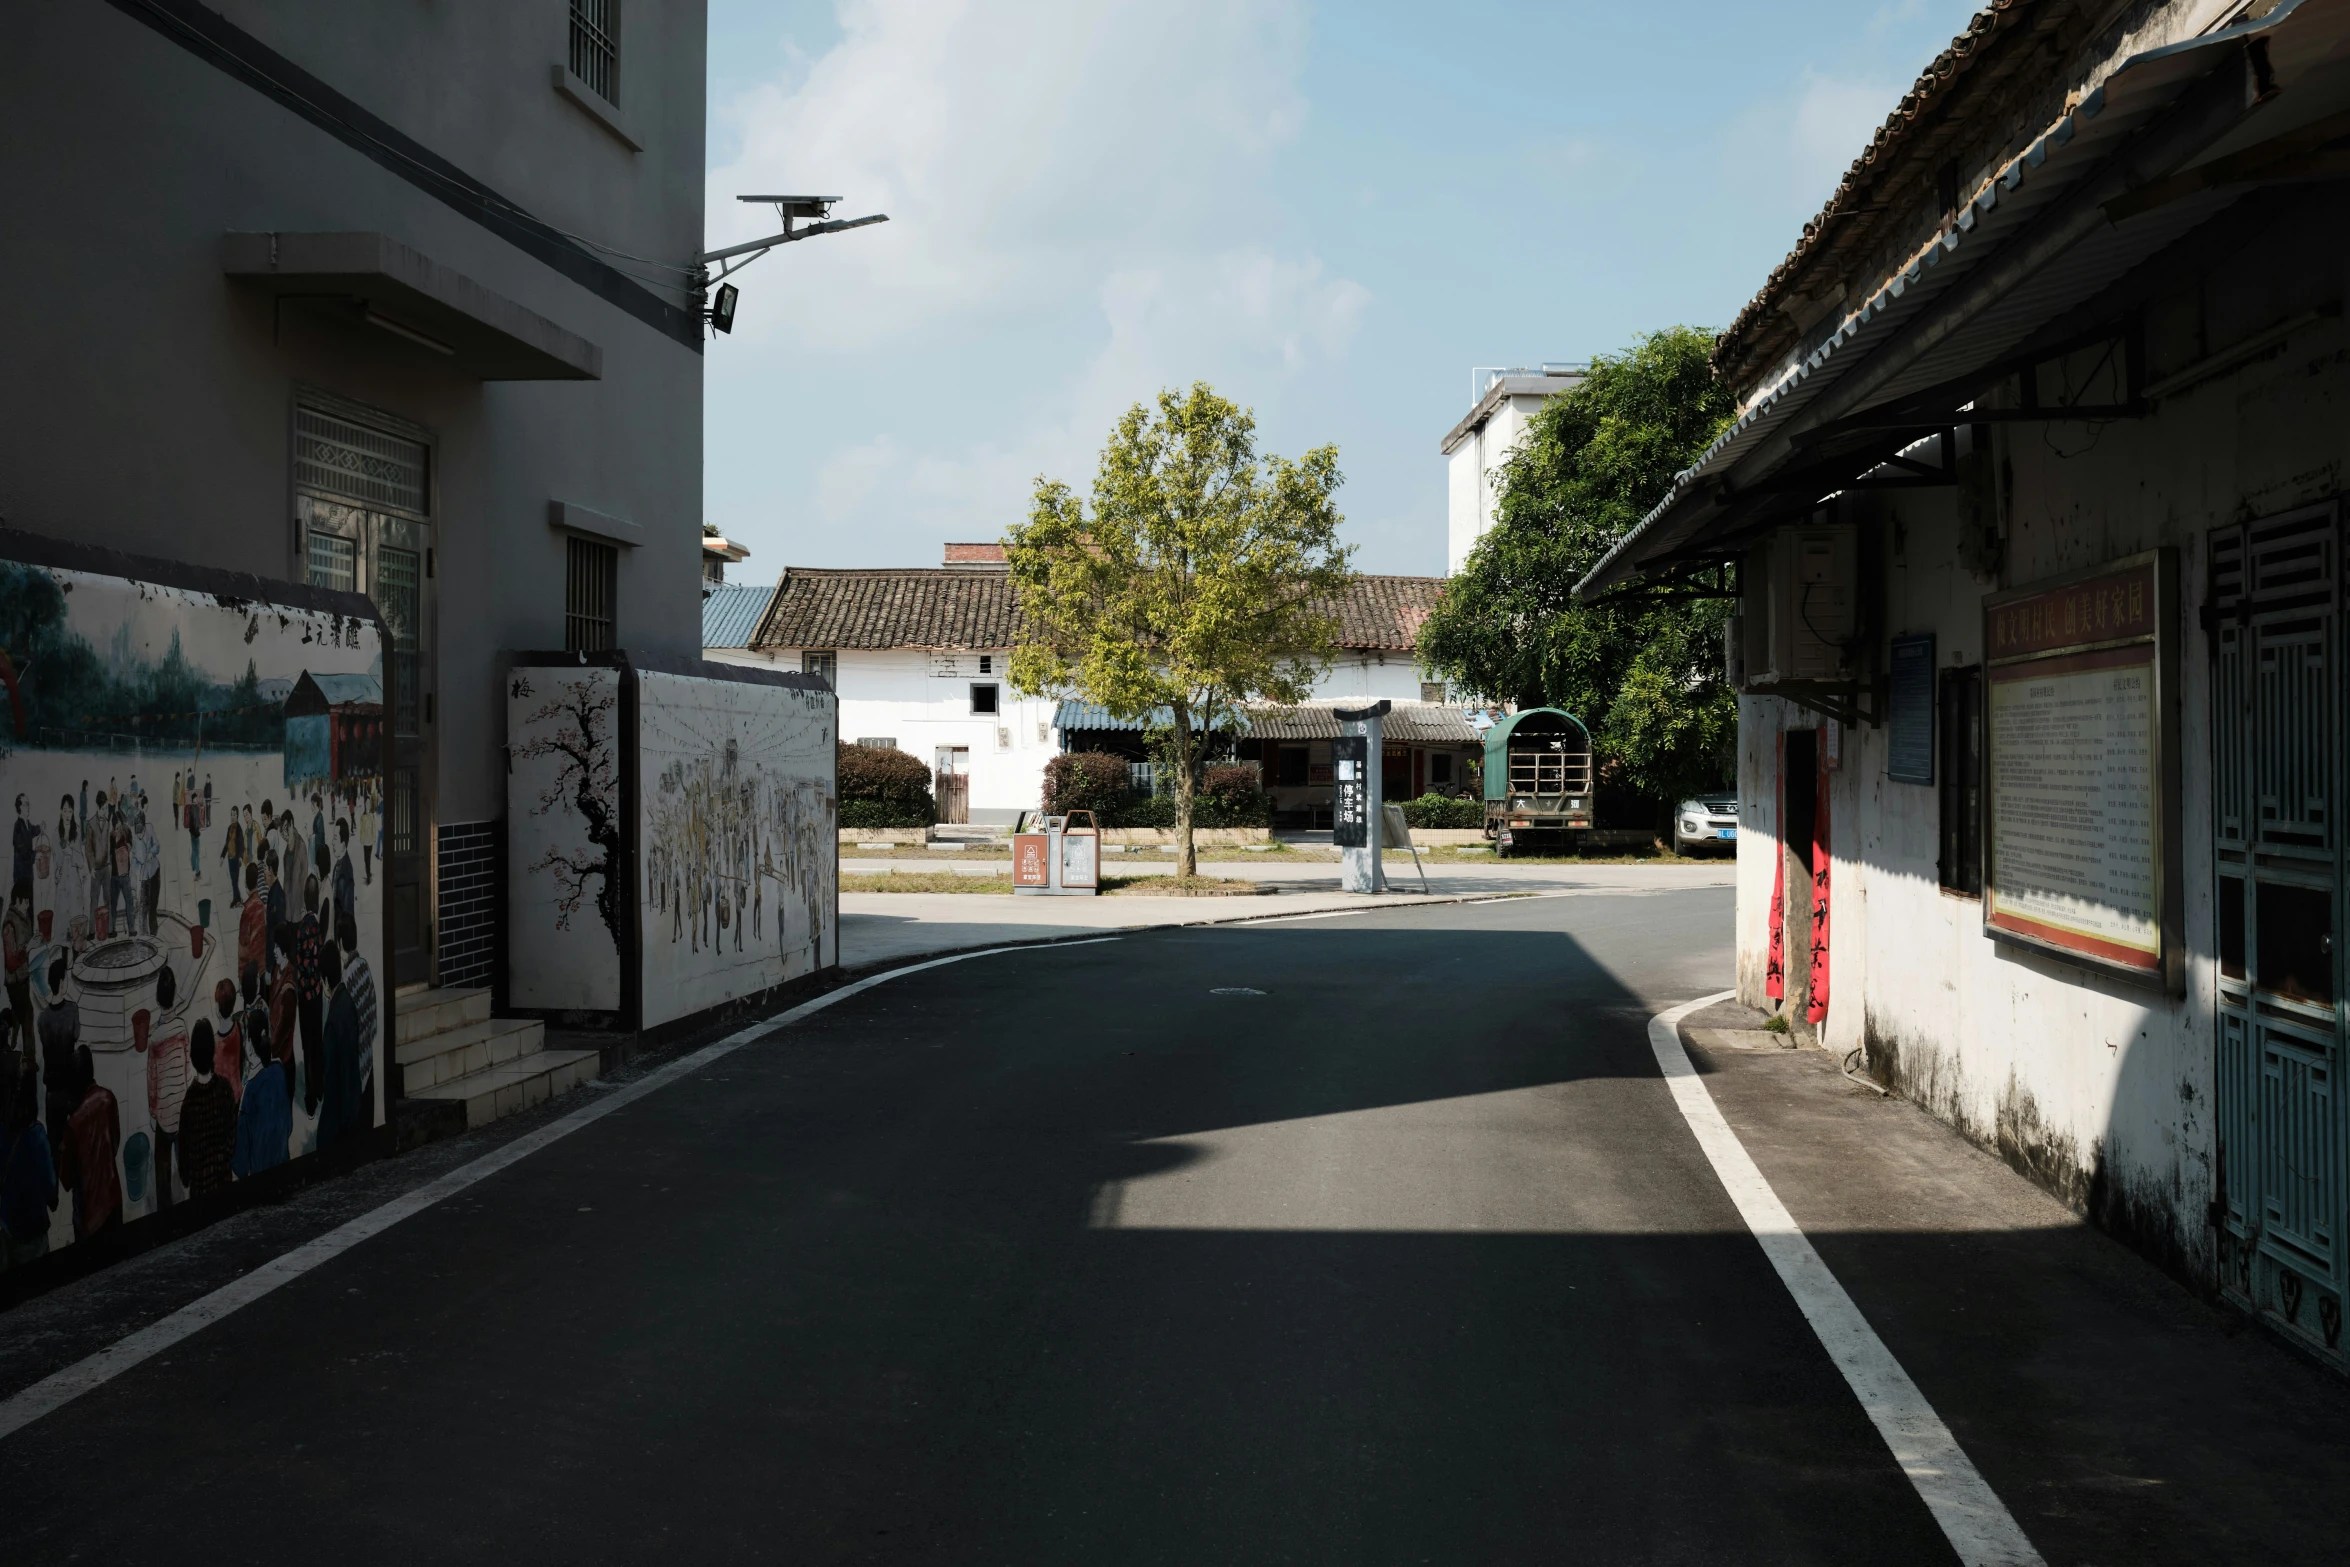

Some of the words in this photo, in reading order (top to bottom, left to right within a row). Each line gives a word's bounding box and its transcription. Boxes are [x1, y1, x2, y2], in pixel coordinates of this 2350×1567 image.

[1996, 602, 2056, 650] 做文明村民
[2063, 580, 2144, 637] 创美好家园
[510, 675, 536, 700] 梅
[1343, 784, 1354, 823] 停车场
[1516, 799, 1526, 808] 大
